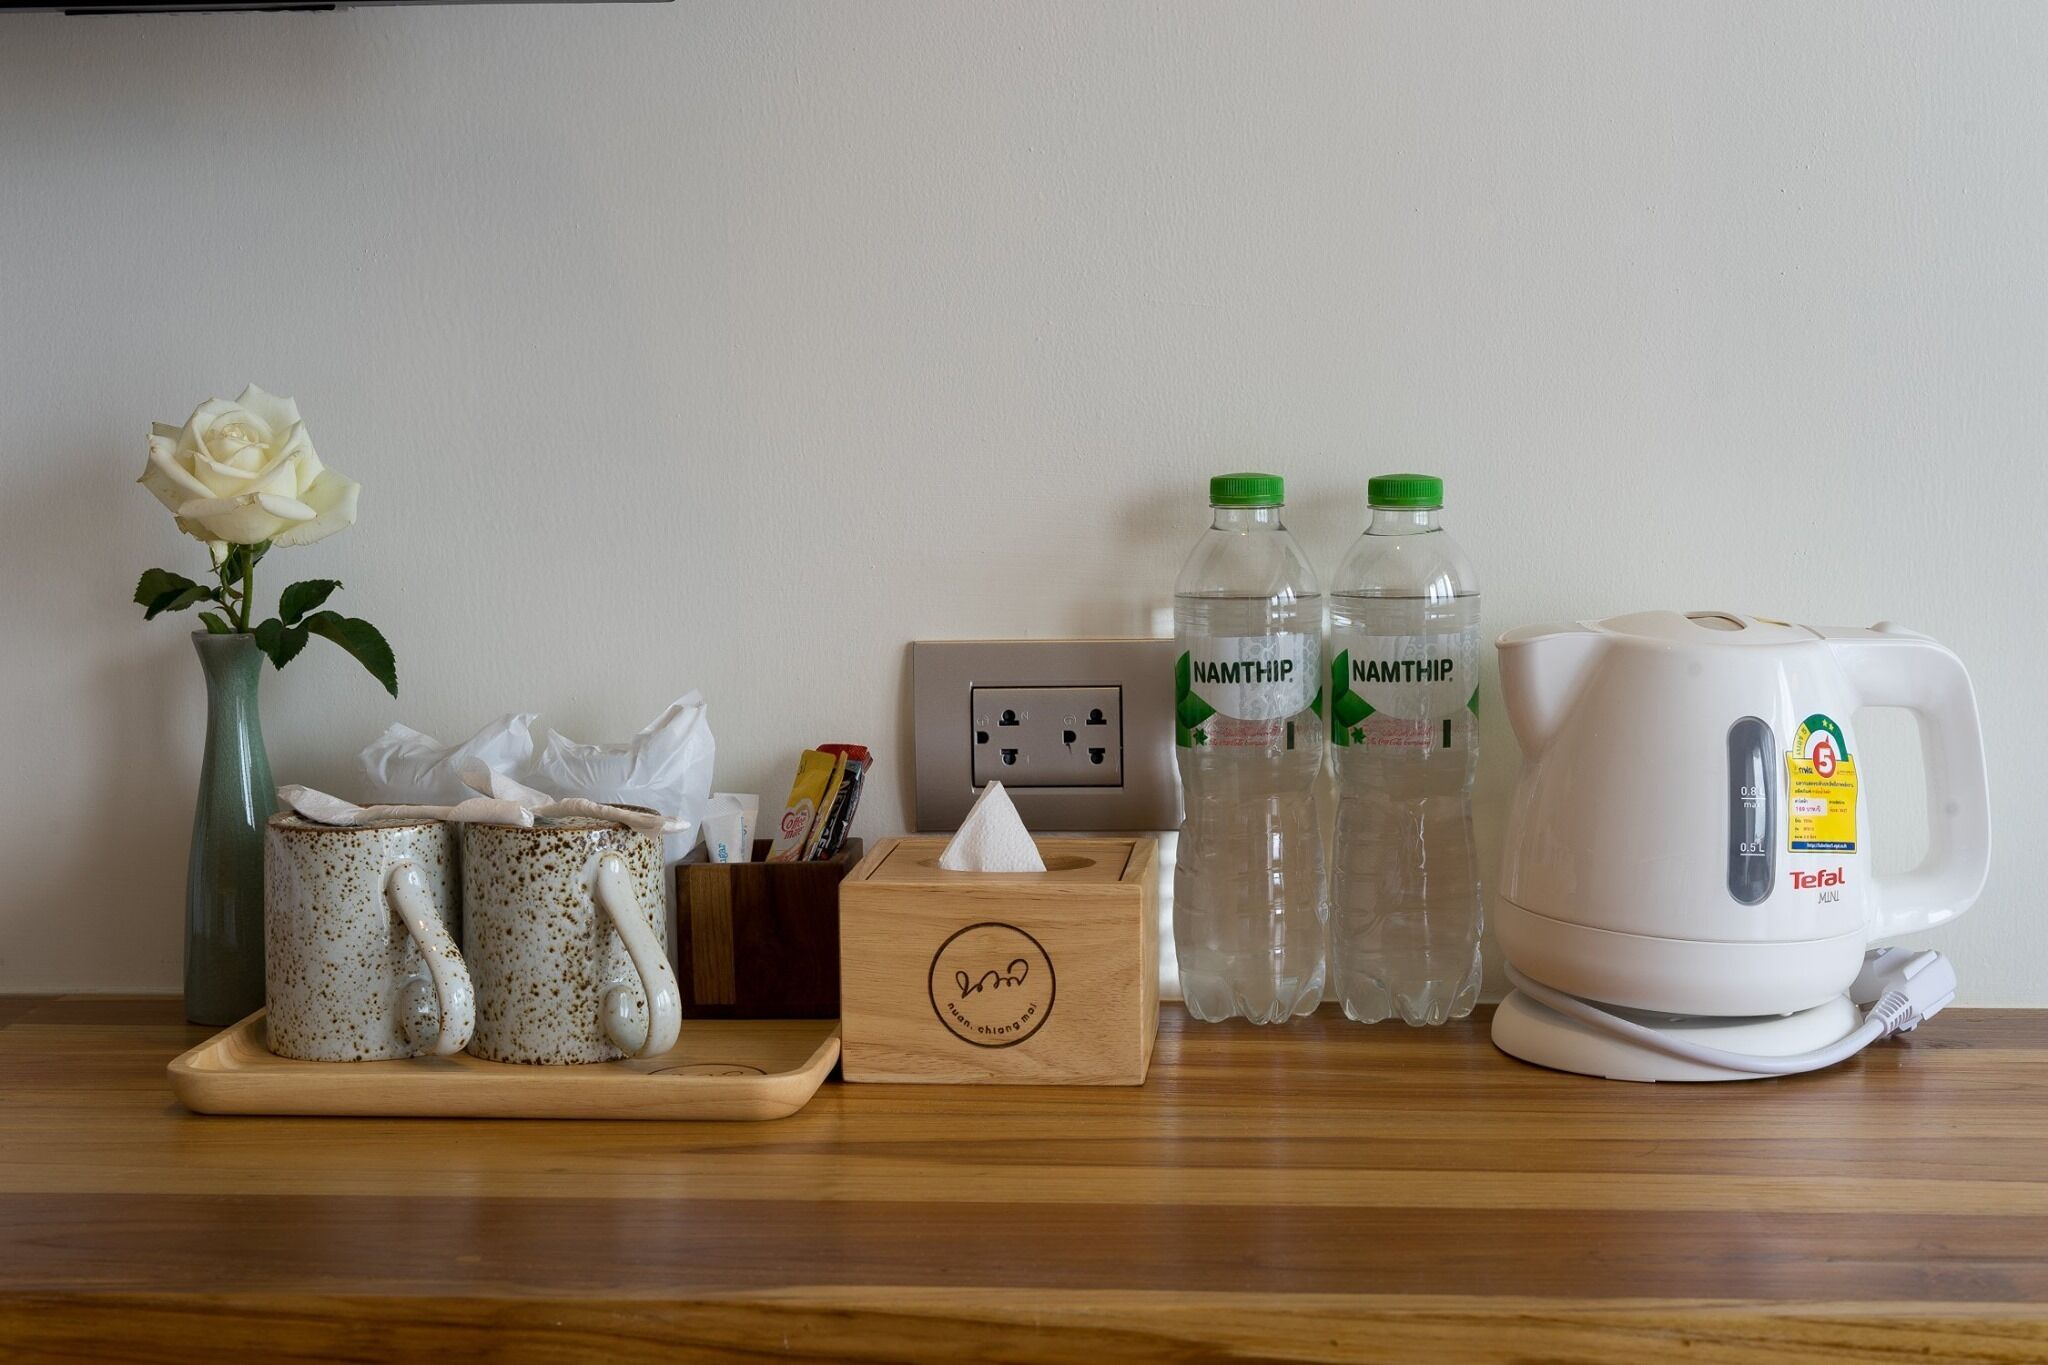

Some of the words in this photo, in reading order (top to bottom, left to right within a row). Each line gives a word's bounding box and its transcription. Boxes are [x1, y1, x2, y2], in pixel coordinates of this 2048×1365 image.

[1194, 659, 1292, 684] NAMTHIP
[1352, 658, 1453, 683] NAMTHIP
[1819, 748, 1833, 774] 5
[1741, 786, 1757, 796] 0.8
[1740, 842, 1756, 852] 0.5
[1789, 867, 1845, 889] Tefal
[1818, 890, 1840, 904] MINI
[978, 1021, 1020, 1035] chiang
[1021, 1002, 1037, 1024] mai
